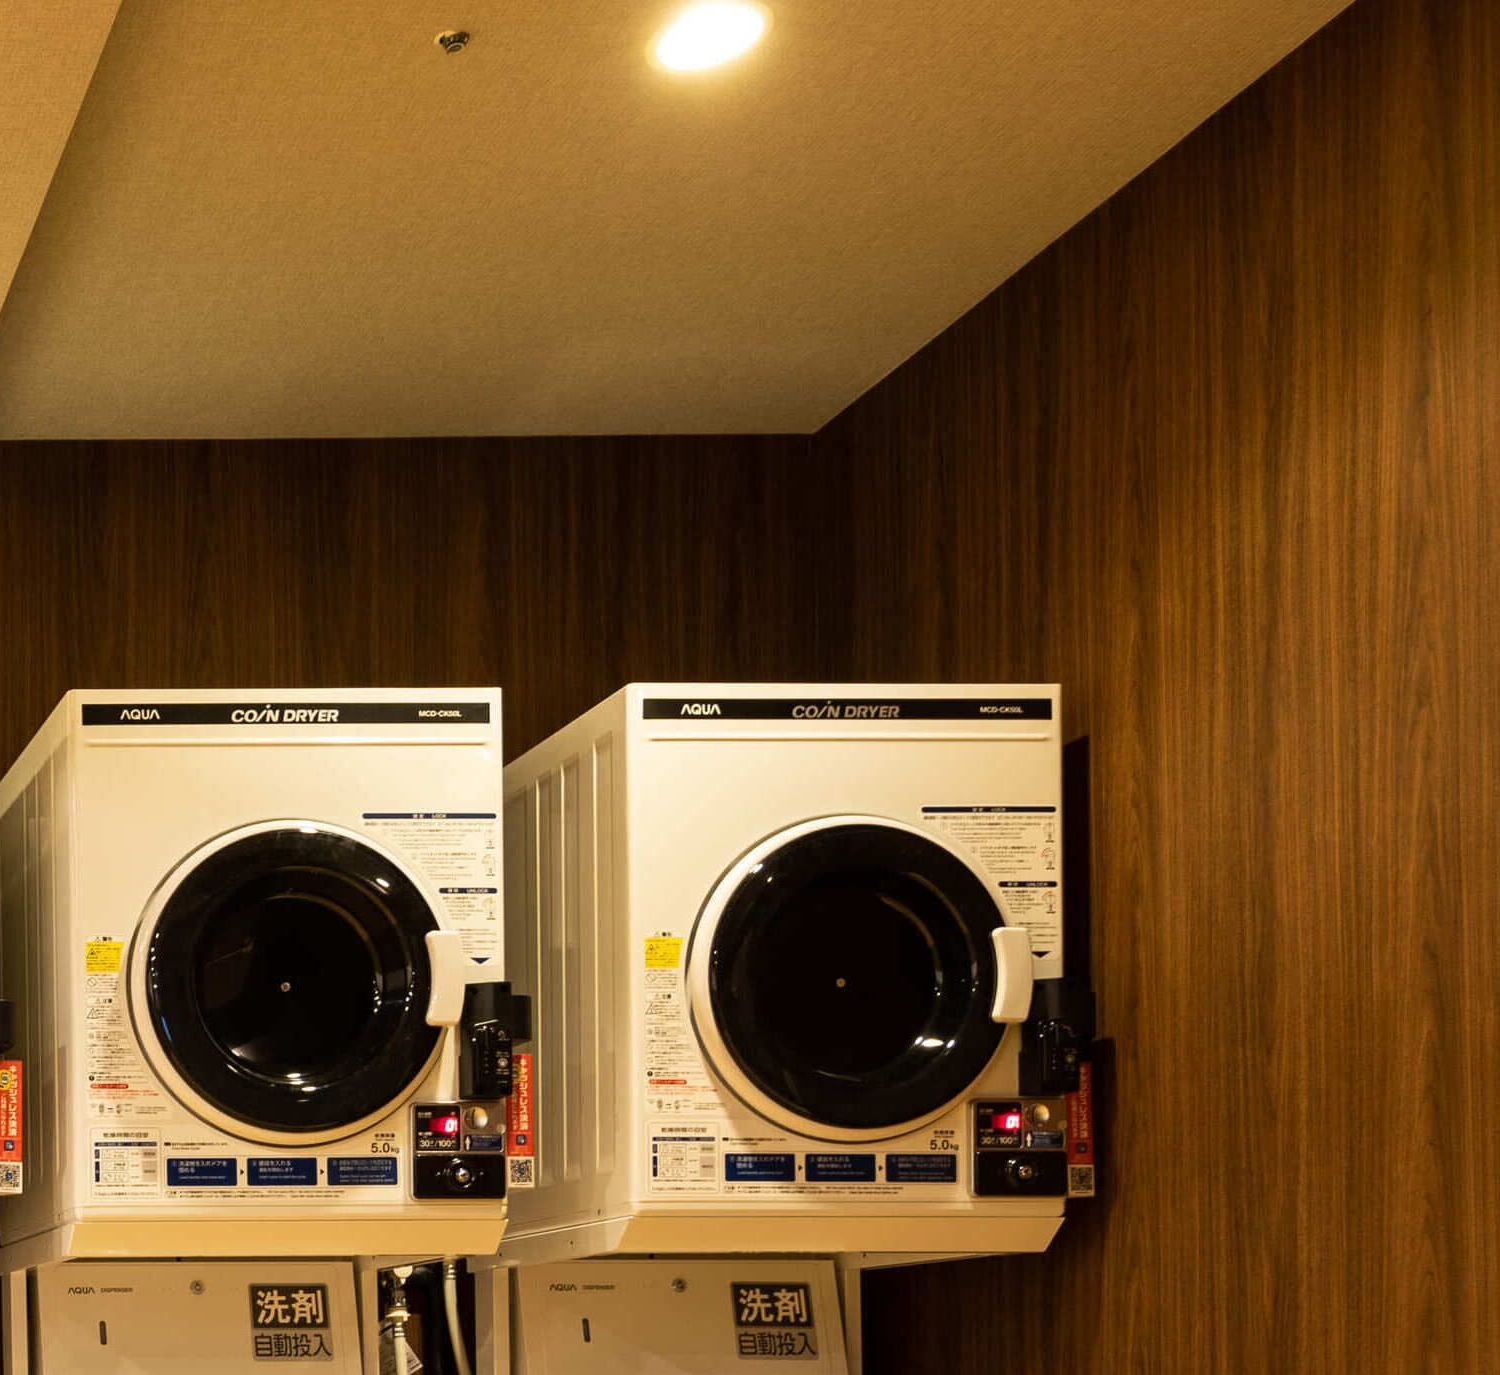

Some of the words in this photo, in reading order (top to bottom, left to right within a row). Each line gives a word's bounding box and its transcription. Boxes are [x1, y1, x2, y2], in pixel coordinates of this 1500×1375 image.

[120, 708, 160, 720] AQUA
[231, 704, 279, 723] COIN
[283, 709, 339, 723] DRYER
[681, 703, 722, 716] AQUA
[792, 700, 839, 719] COIN
[844, 705, 900, 719] DRYER
[8, 1065, 17, 1137] キャッシュレス決済
[67, 1286, 95, 1295] AQUA
[549, 1283, 577, 1292] AQUA
[256, 1289, 324, 1325] 洗剤
[739, 1288, 808, 1323] 洗剤
[253, 1333, 333, 1357] 自動投入
[738, 1332, 816, 1357] 自動投入
